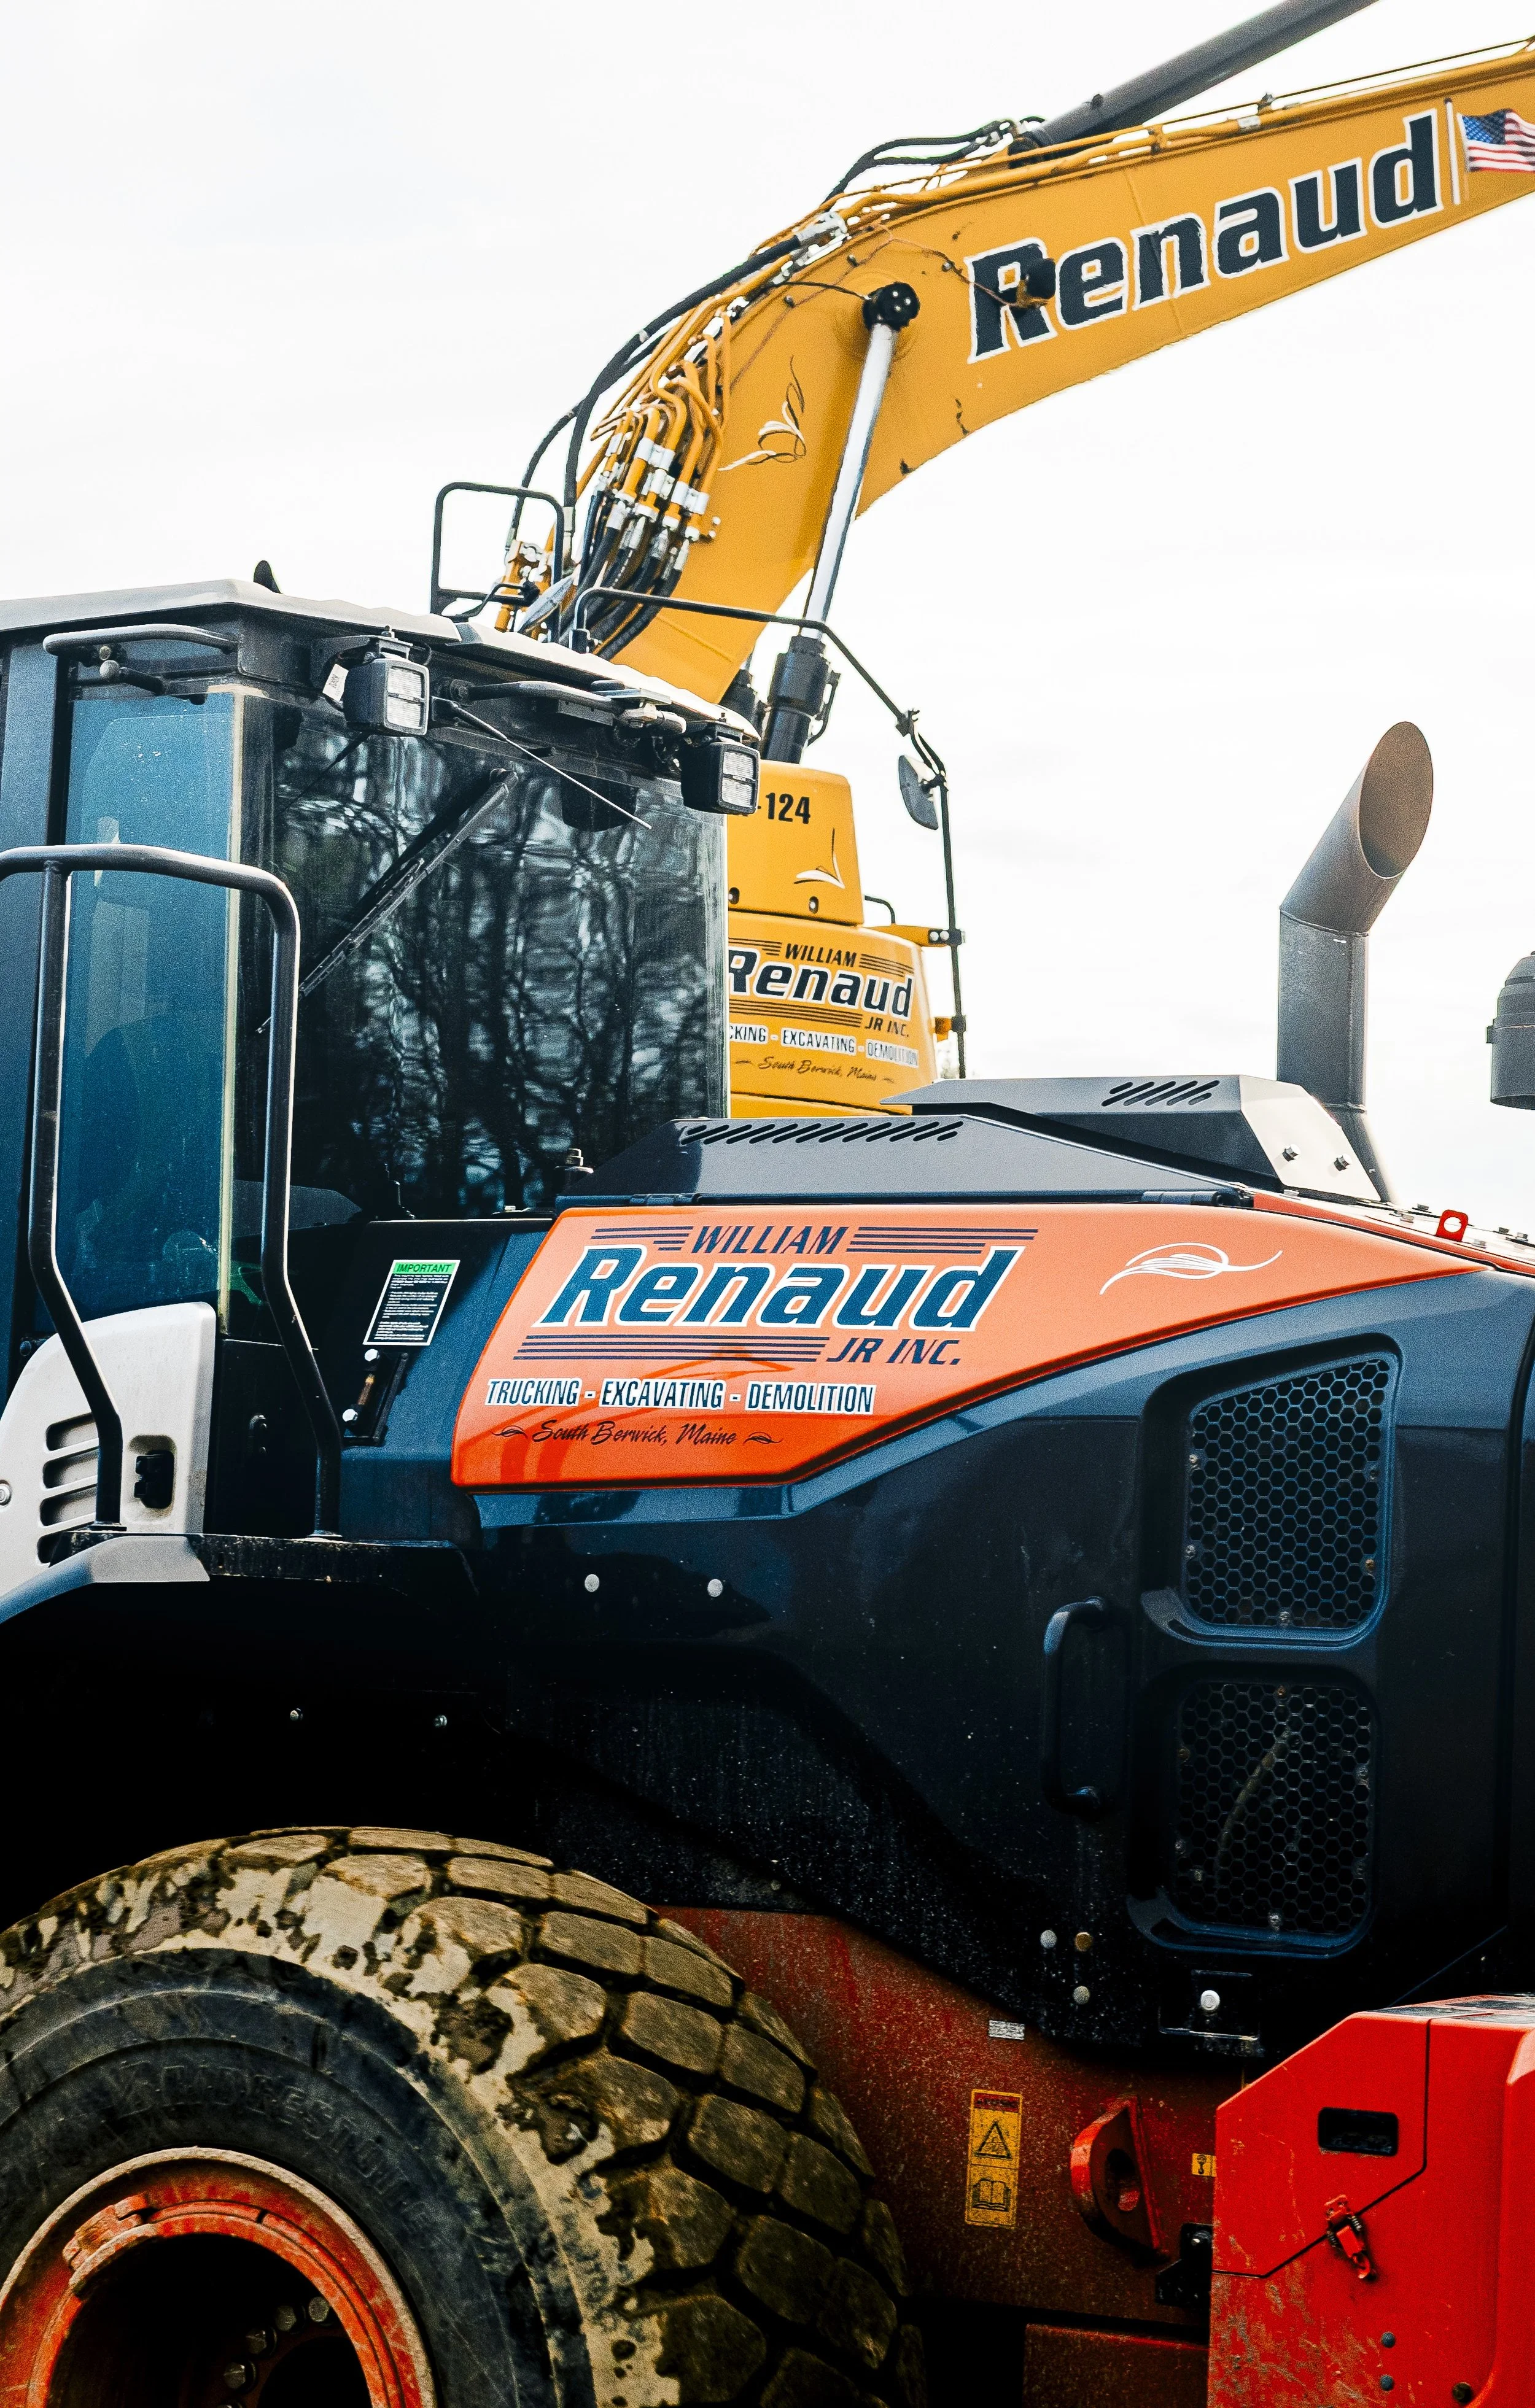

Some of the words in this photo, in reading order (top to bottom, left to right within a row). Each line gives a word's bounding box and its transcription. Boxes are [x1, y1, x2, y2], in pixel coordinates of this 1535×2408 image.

[965, 108, 1444, 364] Renaud
[742, 792, 810, 824] -124
[785, 943, 857, 967] WILLIAM
[728, 946, 915, 1021] Renaud
[729, 1025, 766, 1042] CKING
[782, 1029, 855, 1053] EXCAVATING
[865, 1016, 883, 1031] JR
[887, 1020, 909, 1037] INC.
[691, 1225, 849, 1255] WILLIAM
[396, 1263, 452, 1272] IMPORTANT
[530, 1244, 1025, 1332] Renaud
[826, 1337, 884, 1363] JR
[885, 1338, 961, 1365] INC.
[486, 1380, 580, 1406] TRUCKING
[600, 1380, 725, 1407] EXCAVATING
[747, 1382, 874, 1412] DEMOLITION
[532, 1419, 588, 1442] South
[591, 1420, 667, 1446] Berwick,
[675, 1422, 737, 1445] Maine
